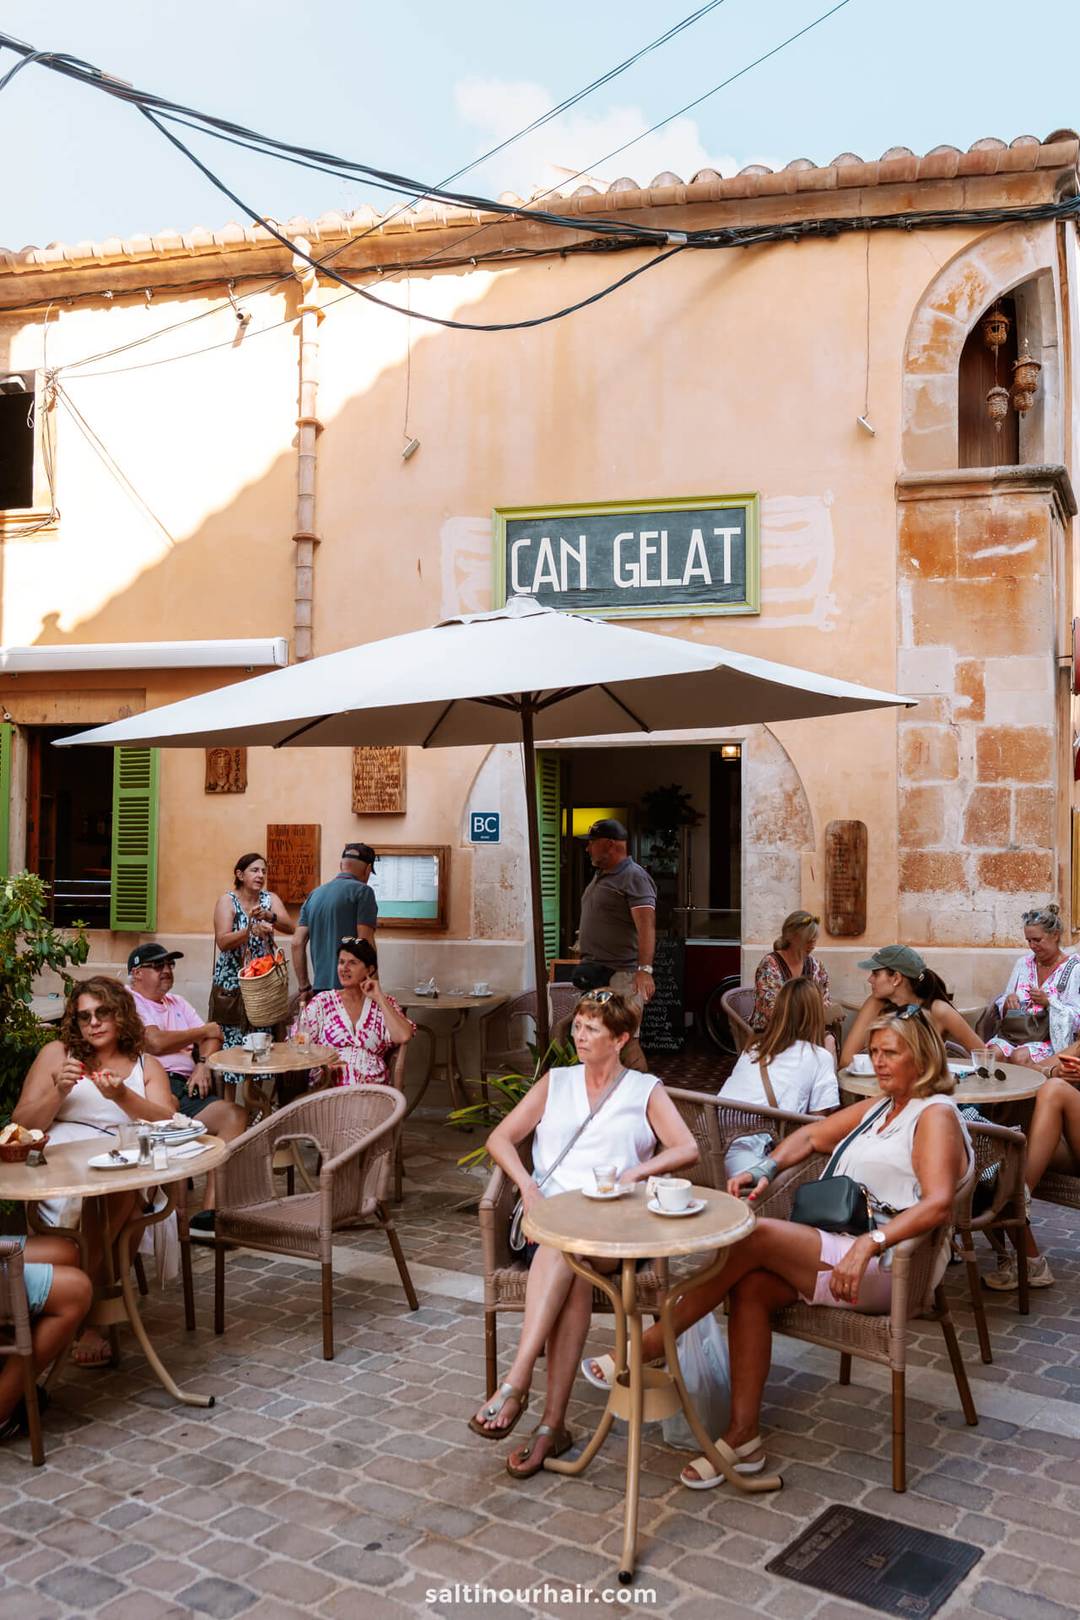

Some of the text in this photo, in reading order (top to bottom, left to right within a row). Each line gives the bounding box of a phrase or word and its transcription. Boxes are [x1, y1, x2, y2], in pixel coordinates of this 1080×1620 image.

[511, 527, 741, 593] CAN GELAT
[474, 816, 497, 833] BC
